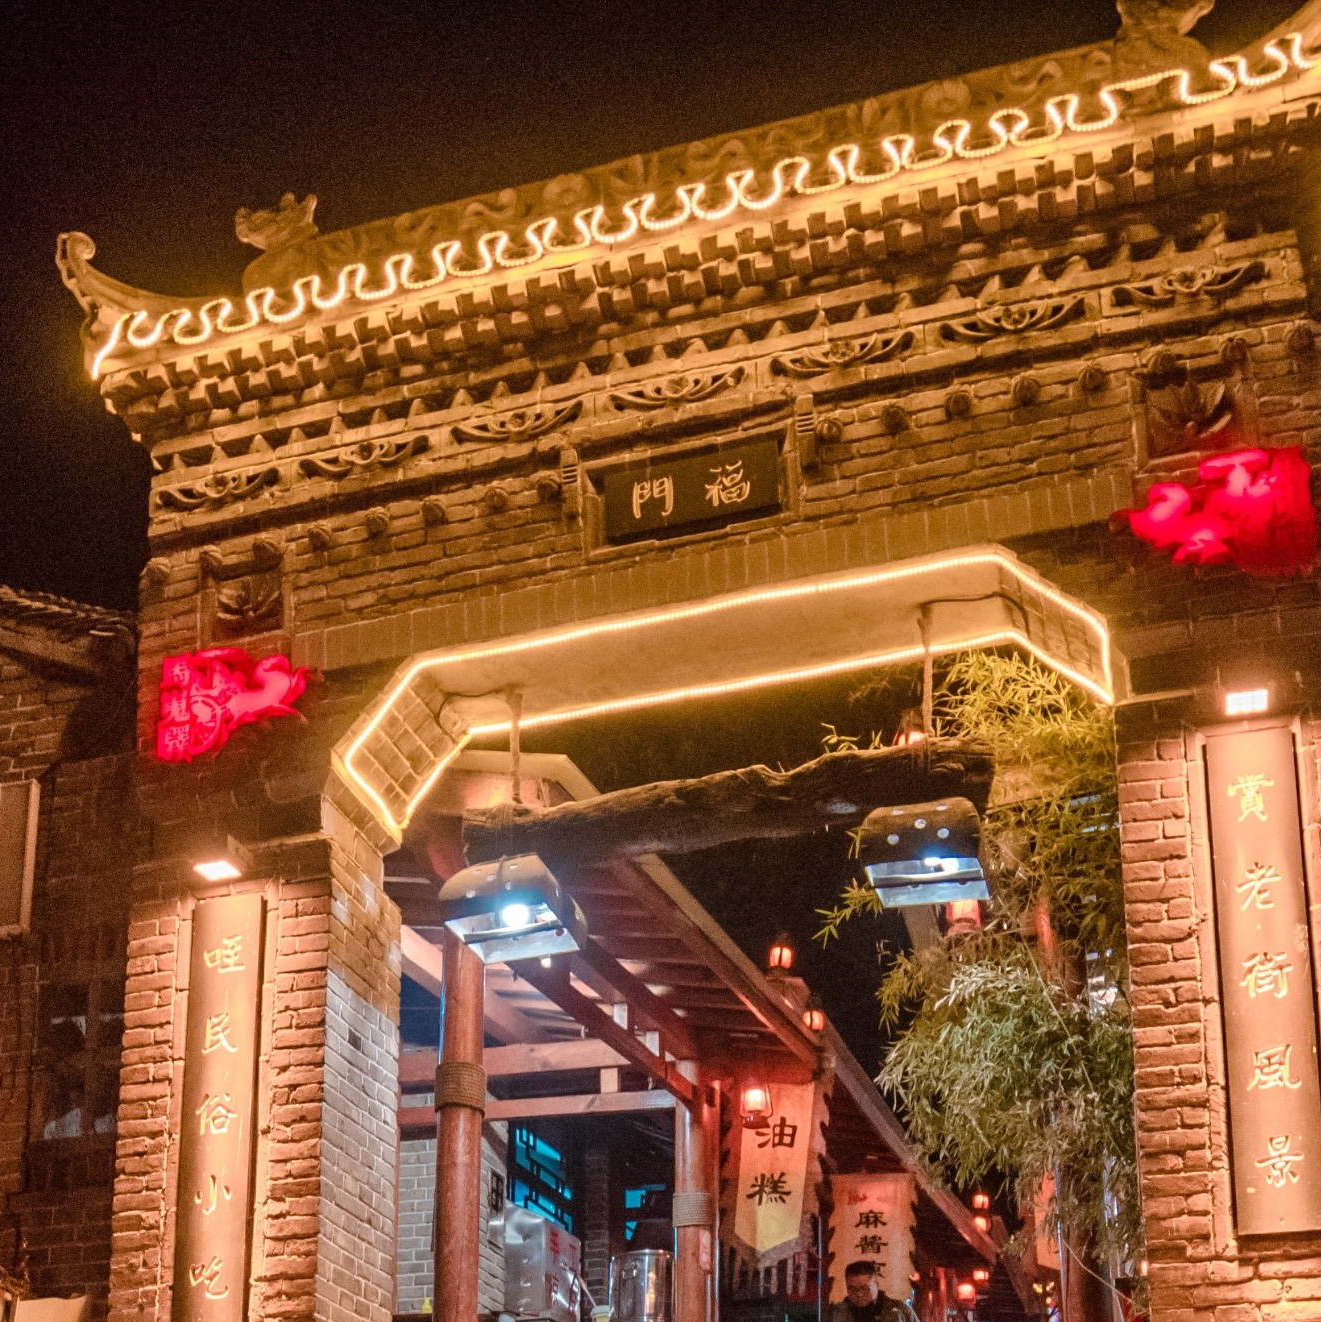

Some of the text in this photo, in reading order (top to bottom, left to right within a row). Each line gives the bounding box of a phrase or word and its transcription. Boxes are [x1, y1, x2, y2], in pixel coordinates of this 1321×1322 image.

[1226, 773, 1306, 1189] 賞老街風景
[745, 1115, 798, 1206] 油糕
